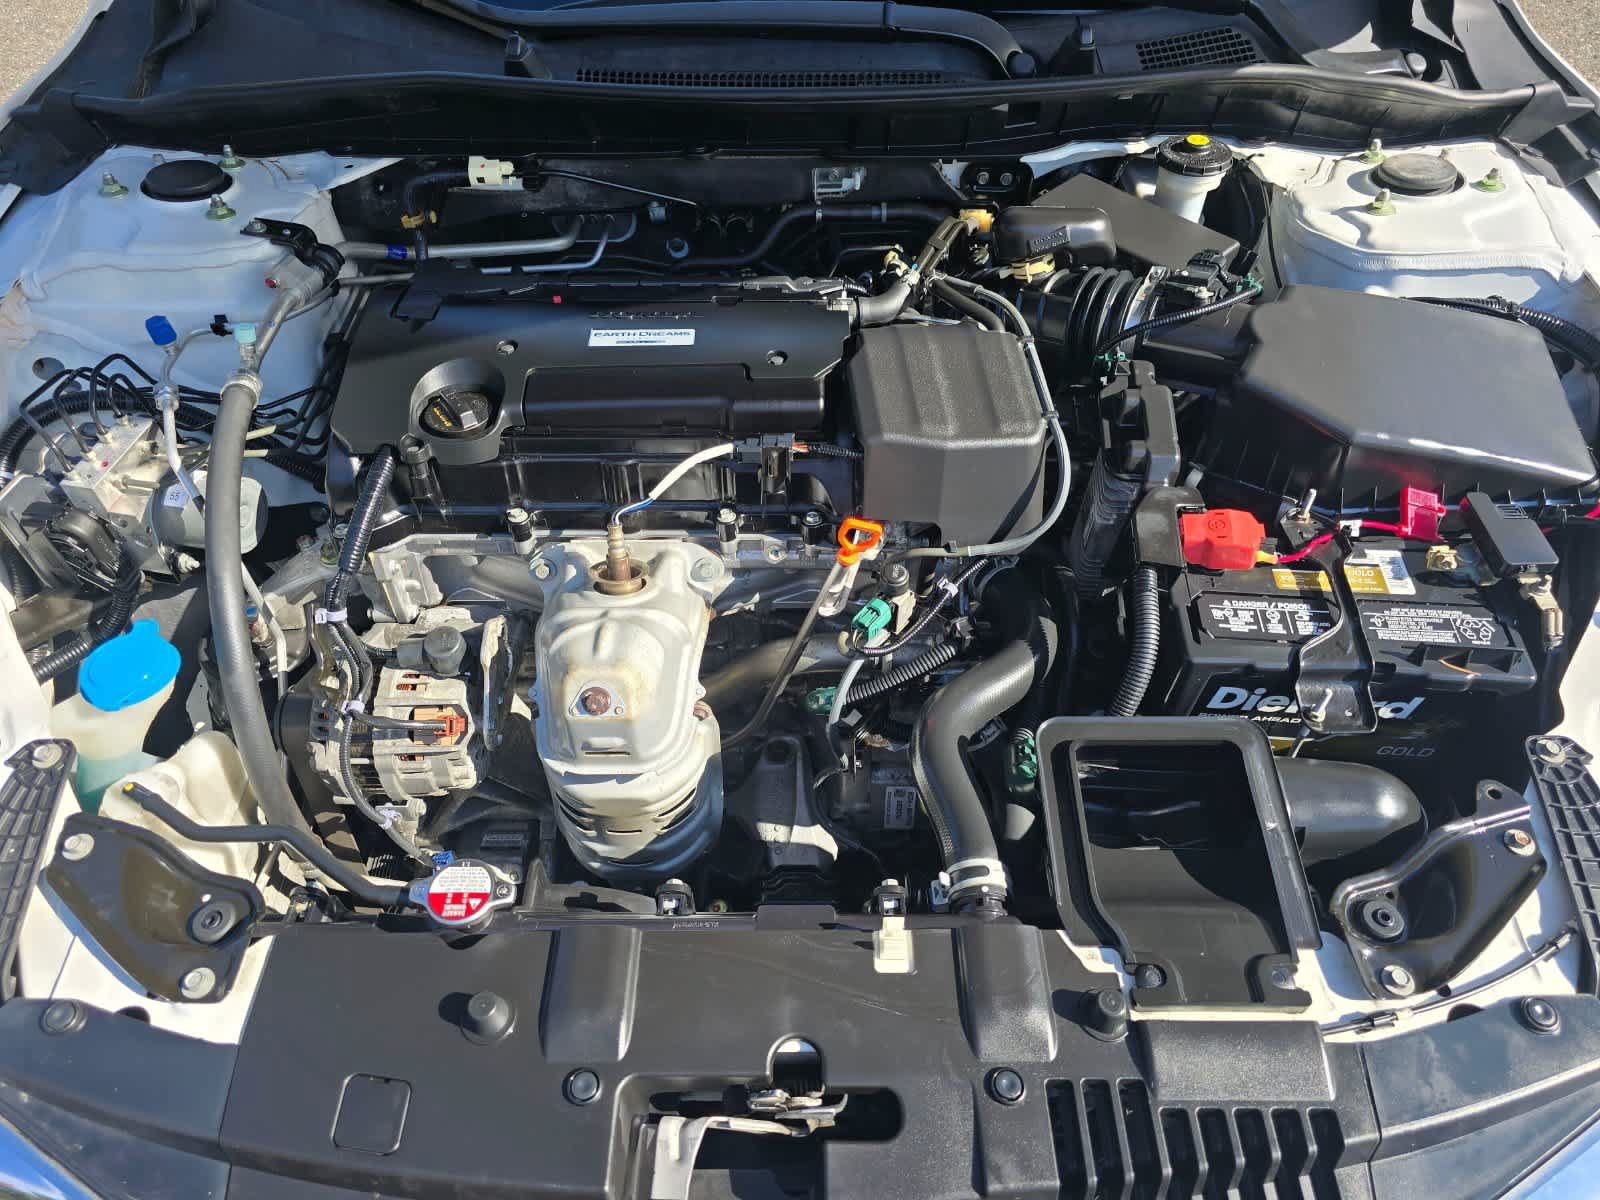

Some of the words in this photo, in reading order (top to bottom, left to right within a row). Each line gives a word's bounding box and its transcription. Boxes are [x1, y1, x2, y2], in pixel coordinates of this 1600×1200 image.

[1231, 600, 1268, 609] DANGER
[1277, 602, 1310, 610] POISON
[1251, 715, 1302, 724] AHEAD
[1375, 745, 1436, 758] GOLD
